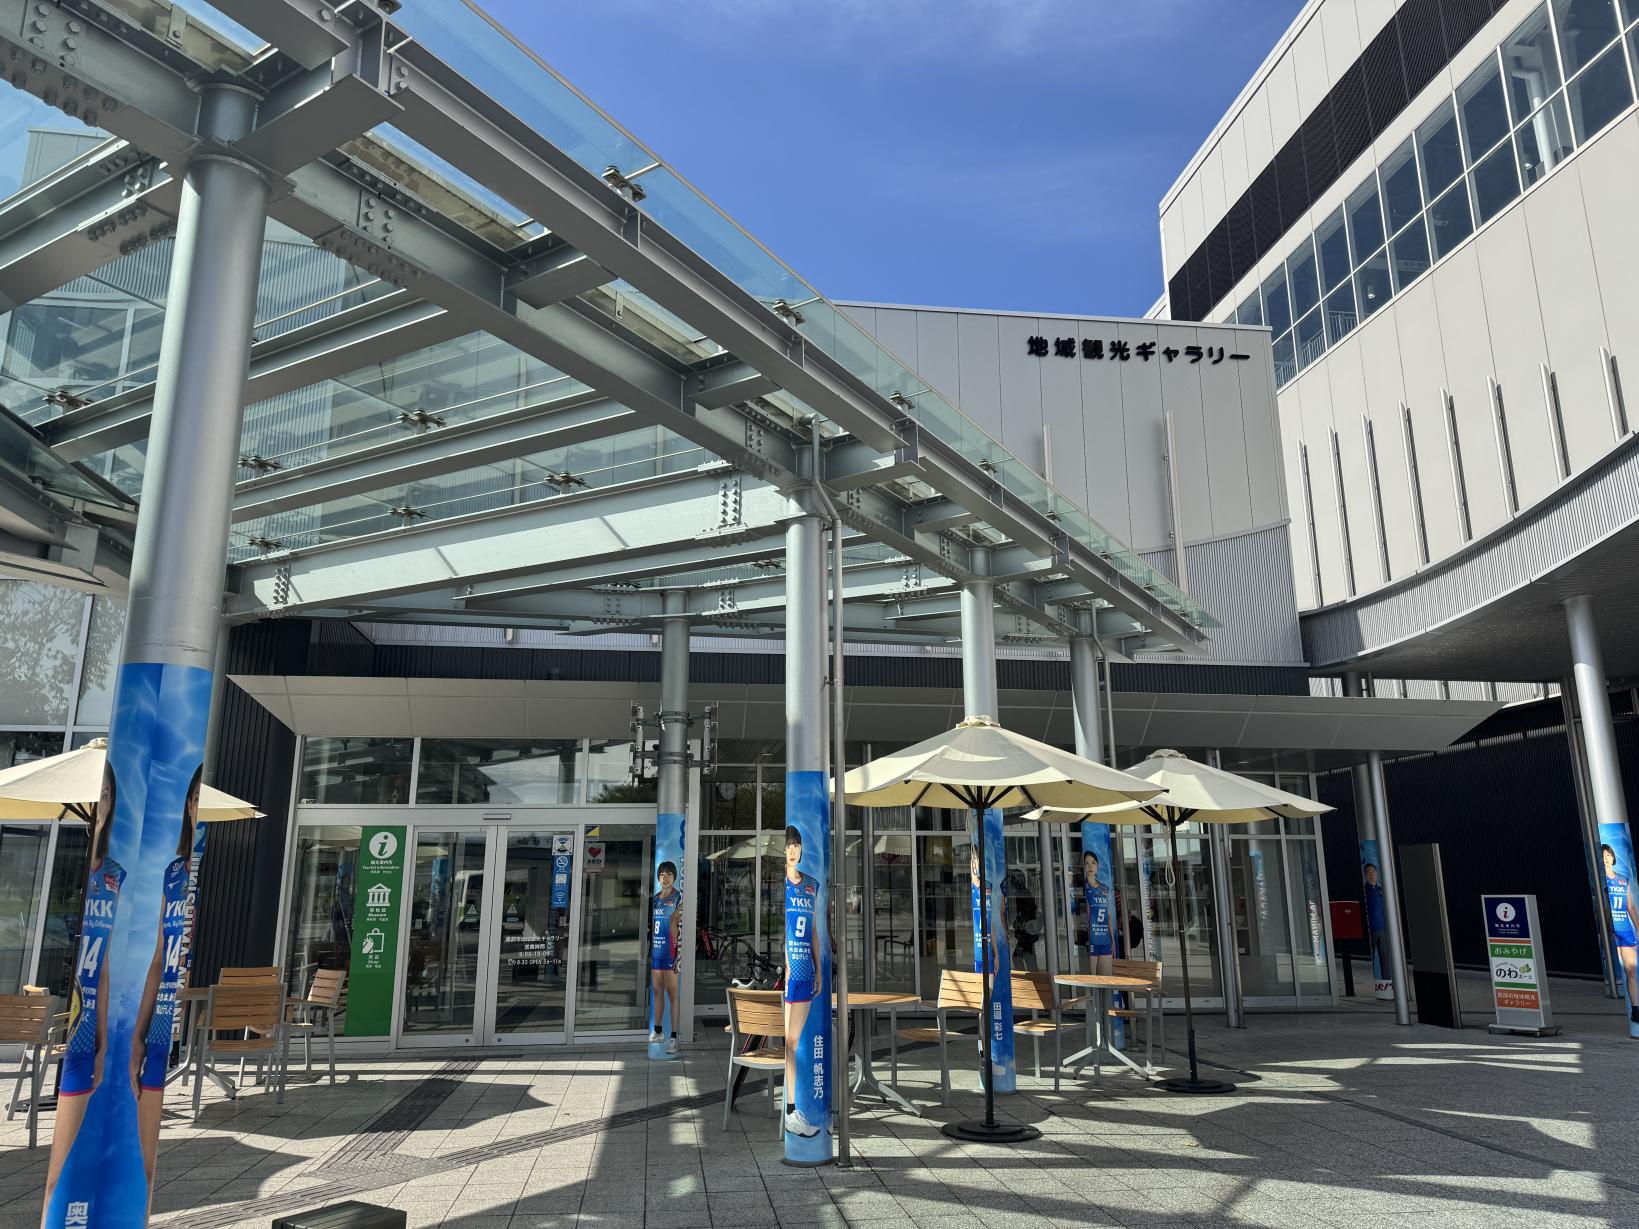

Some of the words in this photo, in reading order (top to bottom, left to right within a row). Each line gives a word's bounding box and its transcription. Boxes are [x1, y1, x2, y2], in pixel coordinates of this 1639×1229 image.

[1028, 336, 1250, 364] 地域観光ギャラリー
[790, 897, 812, 908] YKK
[1613, 896, 1623, 909] 11
[1097, 909, 1106, 922] 5
[655, 921, 661, 934] 8
[795, 916, 807, 937] 9
[78, 935, 103, 977] 14
[164, 935, 182, 973] 14
[1495, 947, 1526, 955] おみやげ
[813, 1035, 824, 1059] 住田
[65, 1201, 89, 1229] 奥
